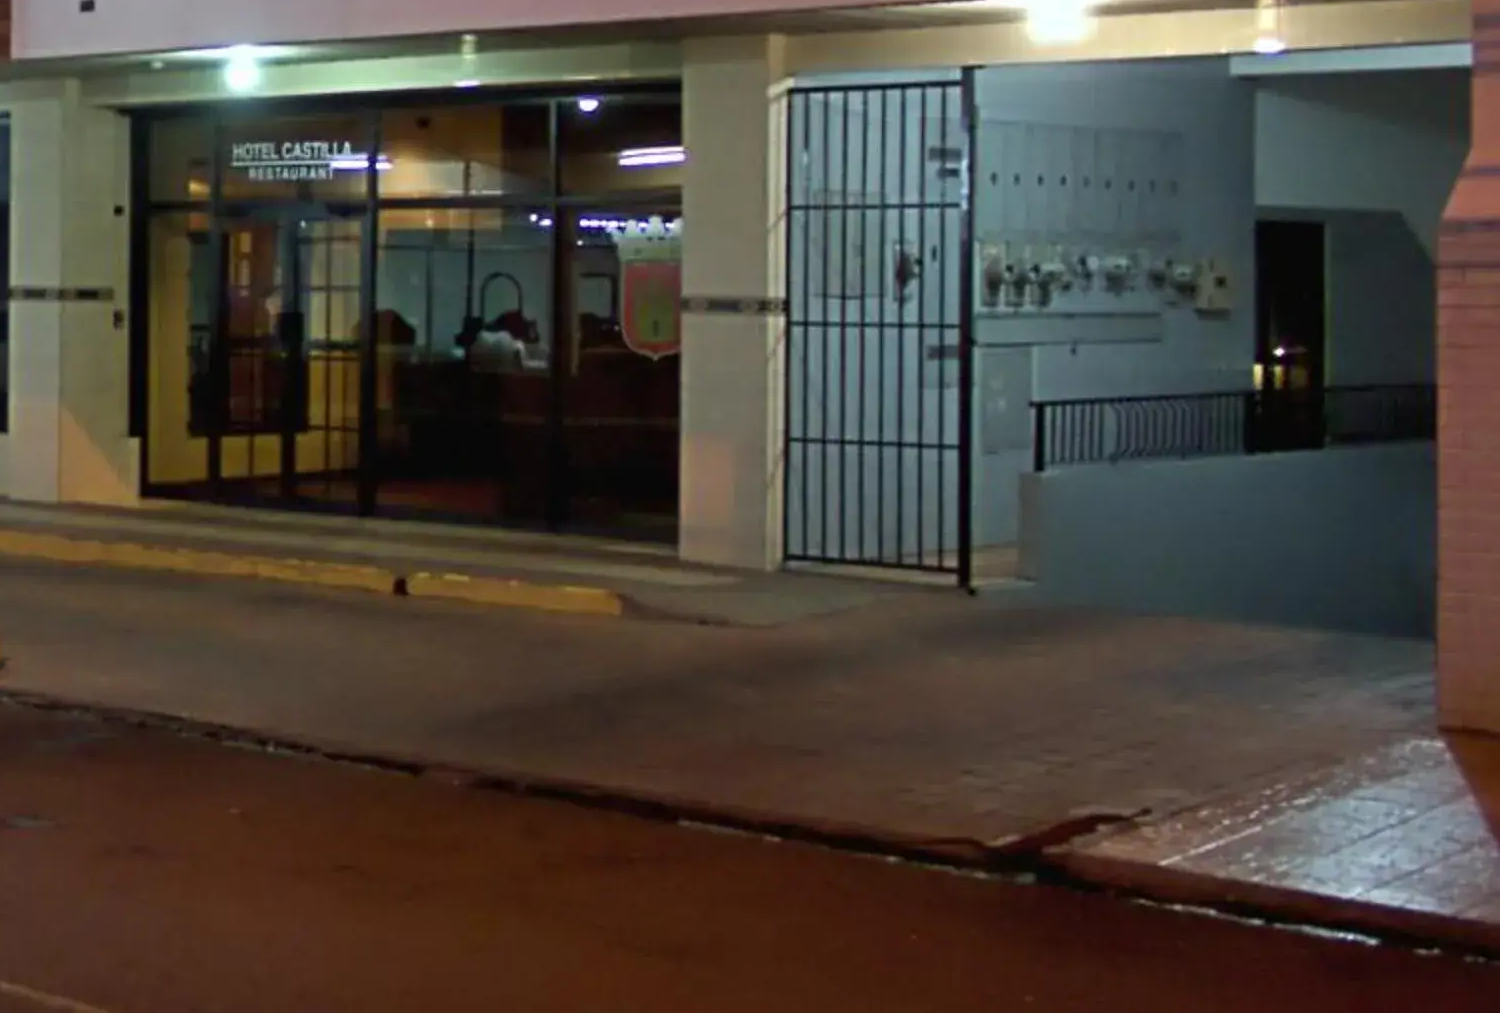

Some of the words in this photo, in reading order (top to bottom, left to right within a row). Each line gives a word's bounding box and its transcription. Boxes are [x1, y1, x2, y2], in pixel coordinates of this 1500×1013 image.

[232, 142, 278, 160] HOTEL
[281, 140, 352, 158] CASTILLA
[248, 166, 334, 181] RESTAURANT
